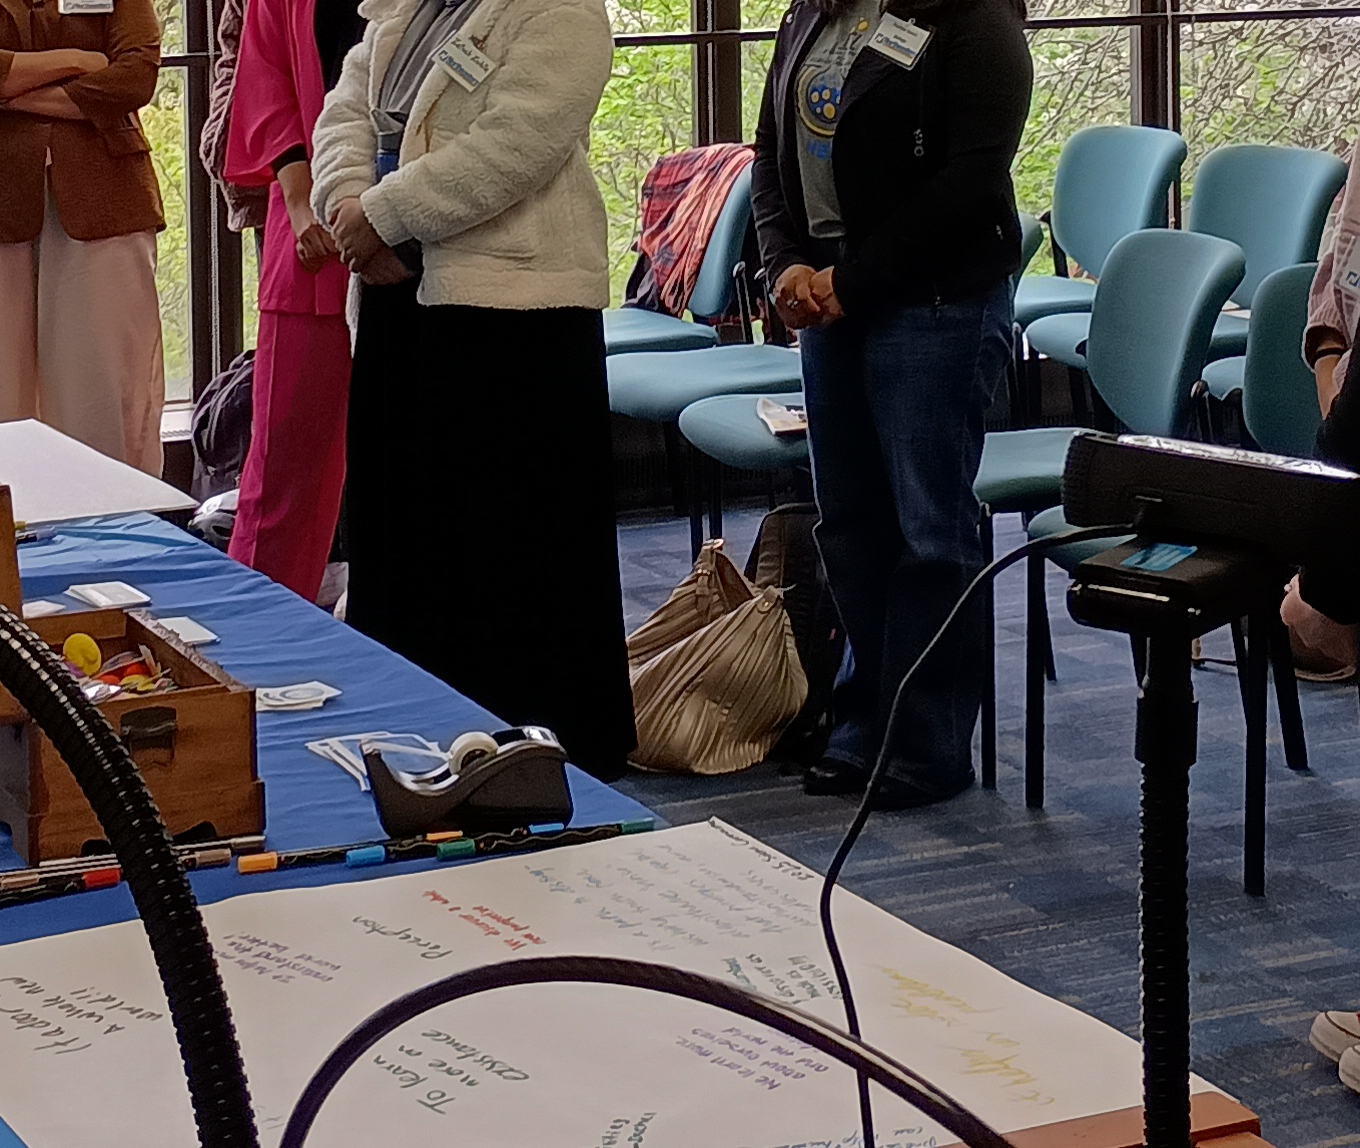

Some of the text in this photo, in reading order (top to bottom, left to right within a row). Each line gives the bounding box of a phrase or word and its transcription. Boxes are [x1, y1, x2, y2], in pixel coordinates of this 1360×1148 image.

[227, 941, 254, 954] the
[352, 915, 453, 959] Perception
[0, 977, 45, 995] new
[42, 995, 104, 1023] whole
[691, 1028, 760, 1061] ourselves
[721, 1027, 768, 1045] world
[770, 1045, 794, 1057] the
[428, 1058, 480, 1087] more
[710, 1056, 756, 1078] learn
[759, 1060, 806, 1080] about
[795, 1057, 829, 1072] and
[373, 1054, 456, 1115] To learn
